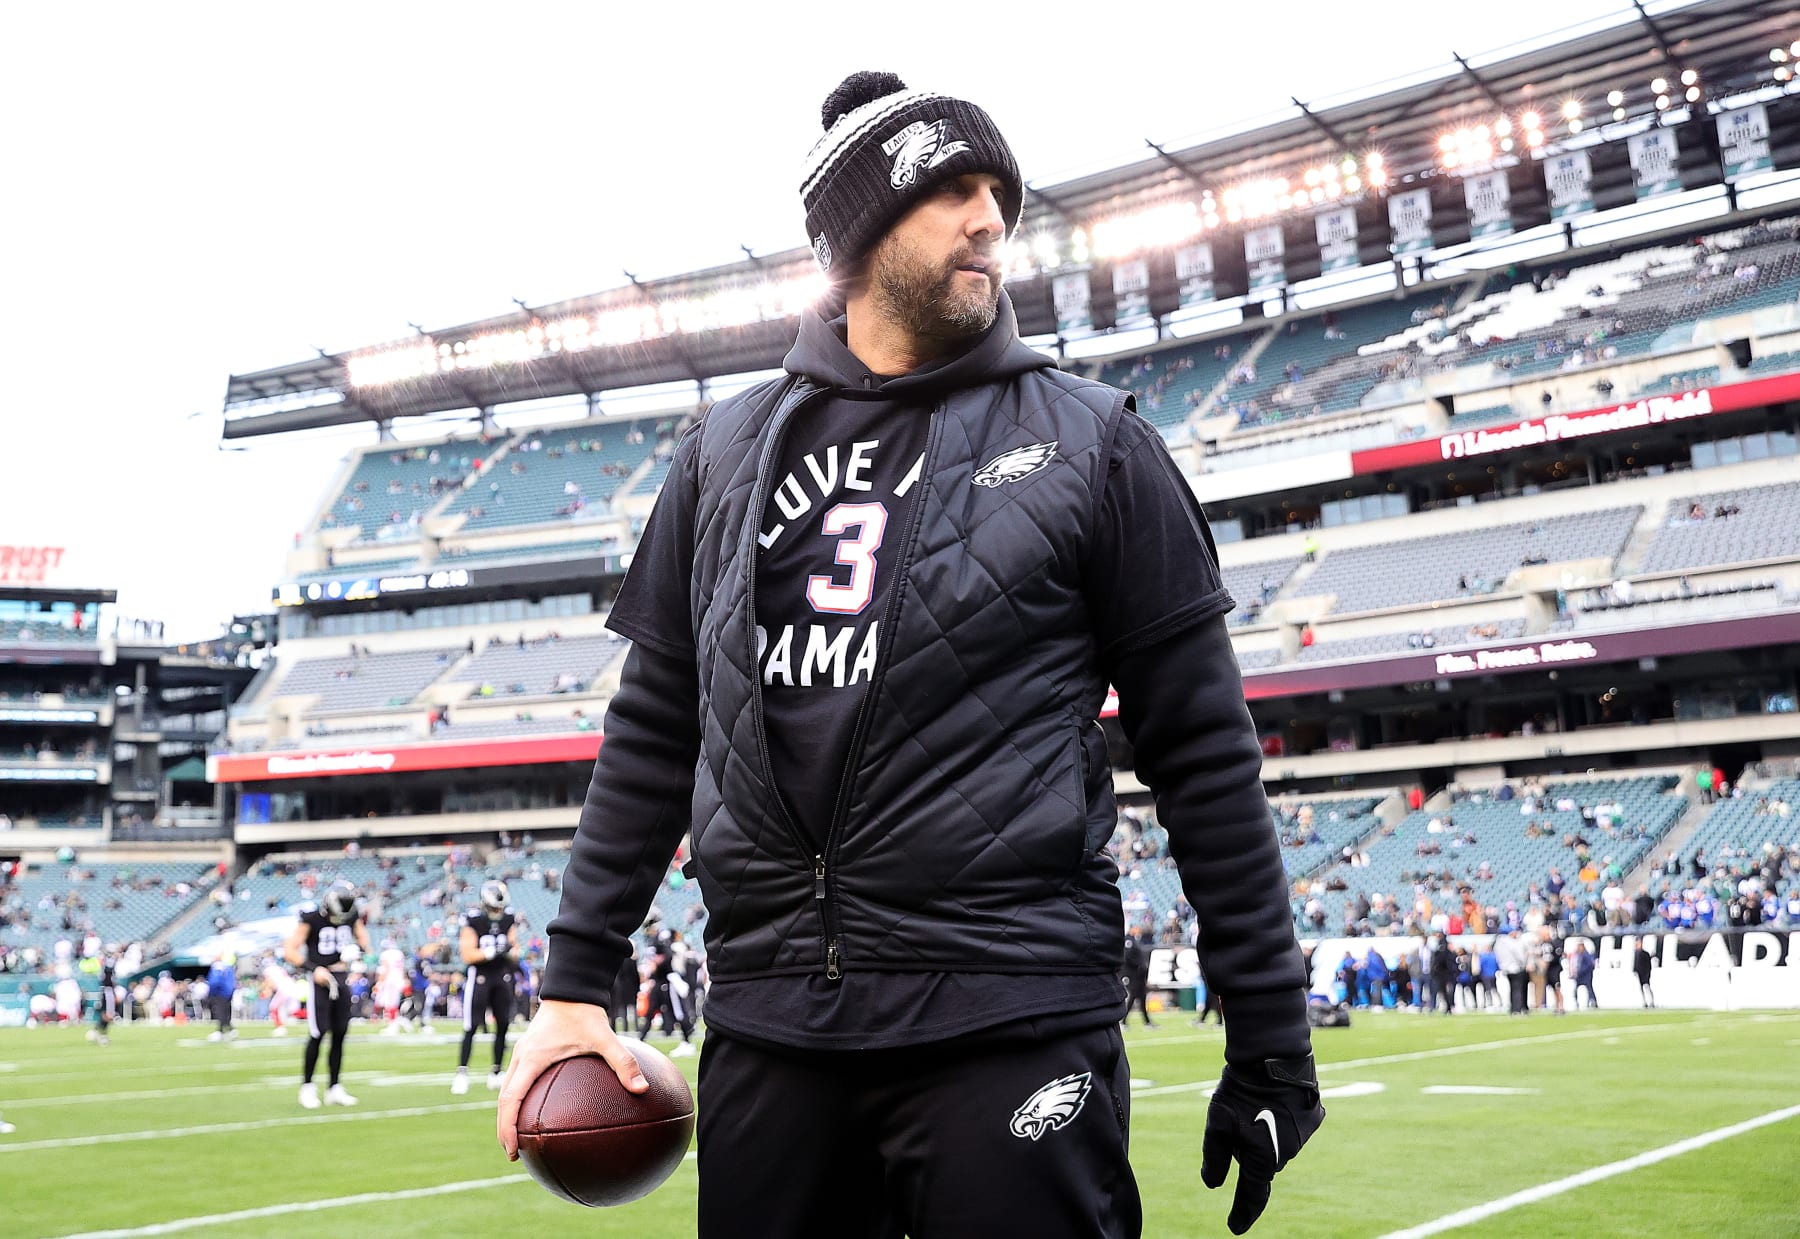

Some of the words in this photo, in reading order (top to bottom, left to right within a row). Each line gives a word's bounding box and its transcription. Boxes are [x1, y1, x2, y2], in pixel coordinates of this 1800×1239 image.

[886, 121, 921, 151] EAGLES
[941, 142, 960, 157] NFC
[805, 501, 889, 616] 3
[1563, 931, 1800, 968] PHILAD
